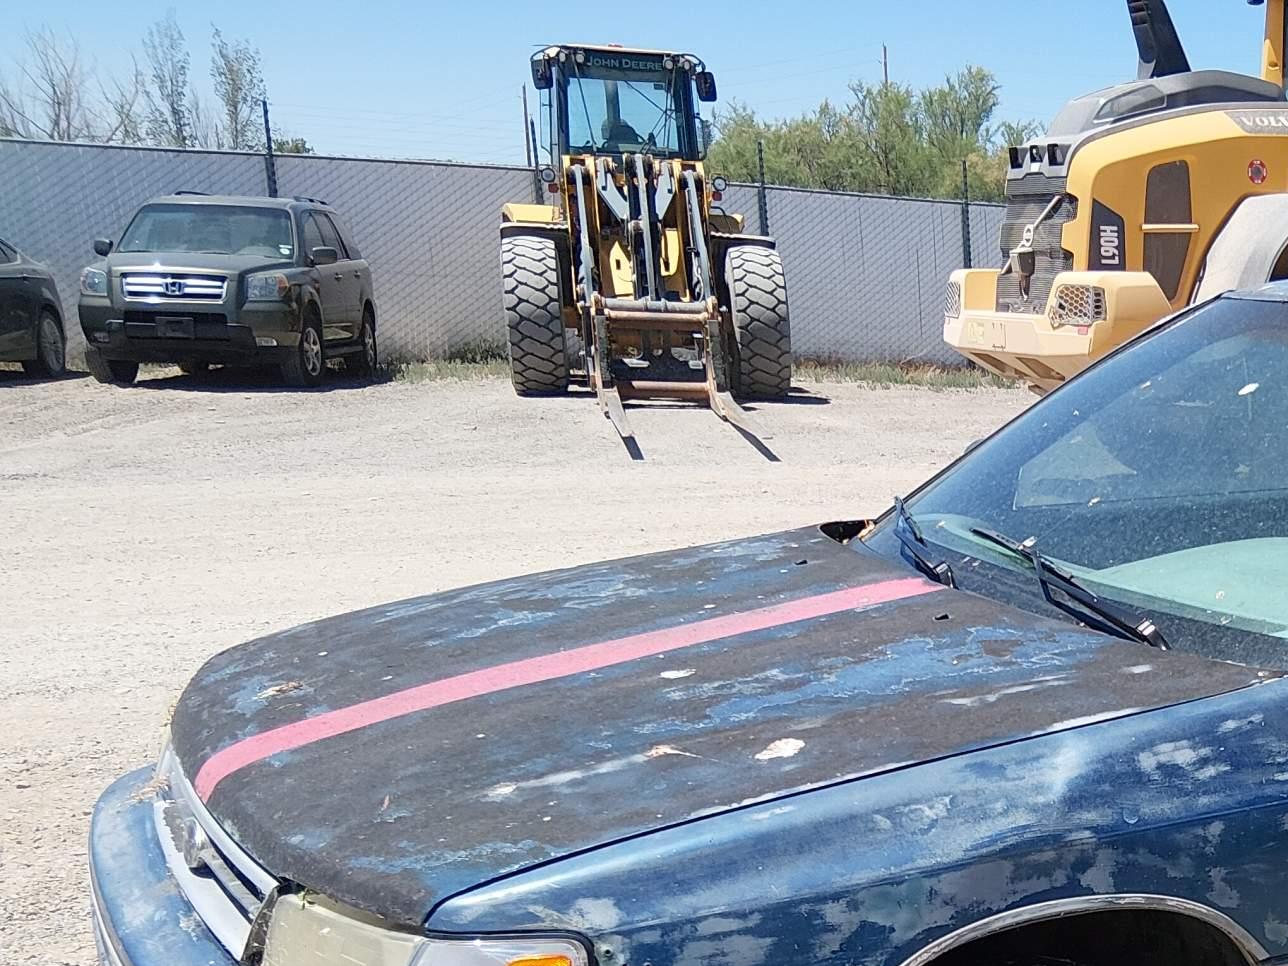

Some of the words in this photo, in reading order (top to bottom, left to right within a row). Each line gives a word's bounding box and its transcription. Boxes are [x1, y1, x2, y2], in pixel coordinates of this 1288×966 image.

[586, 56, 620, 68] JOHN
[622, 59, 662, 71] DEERE
[1100, 225, 1120, 265] L90H
